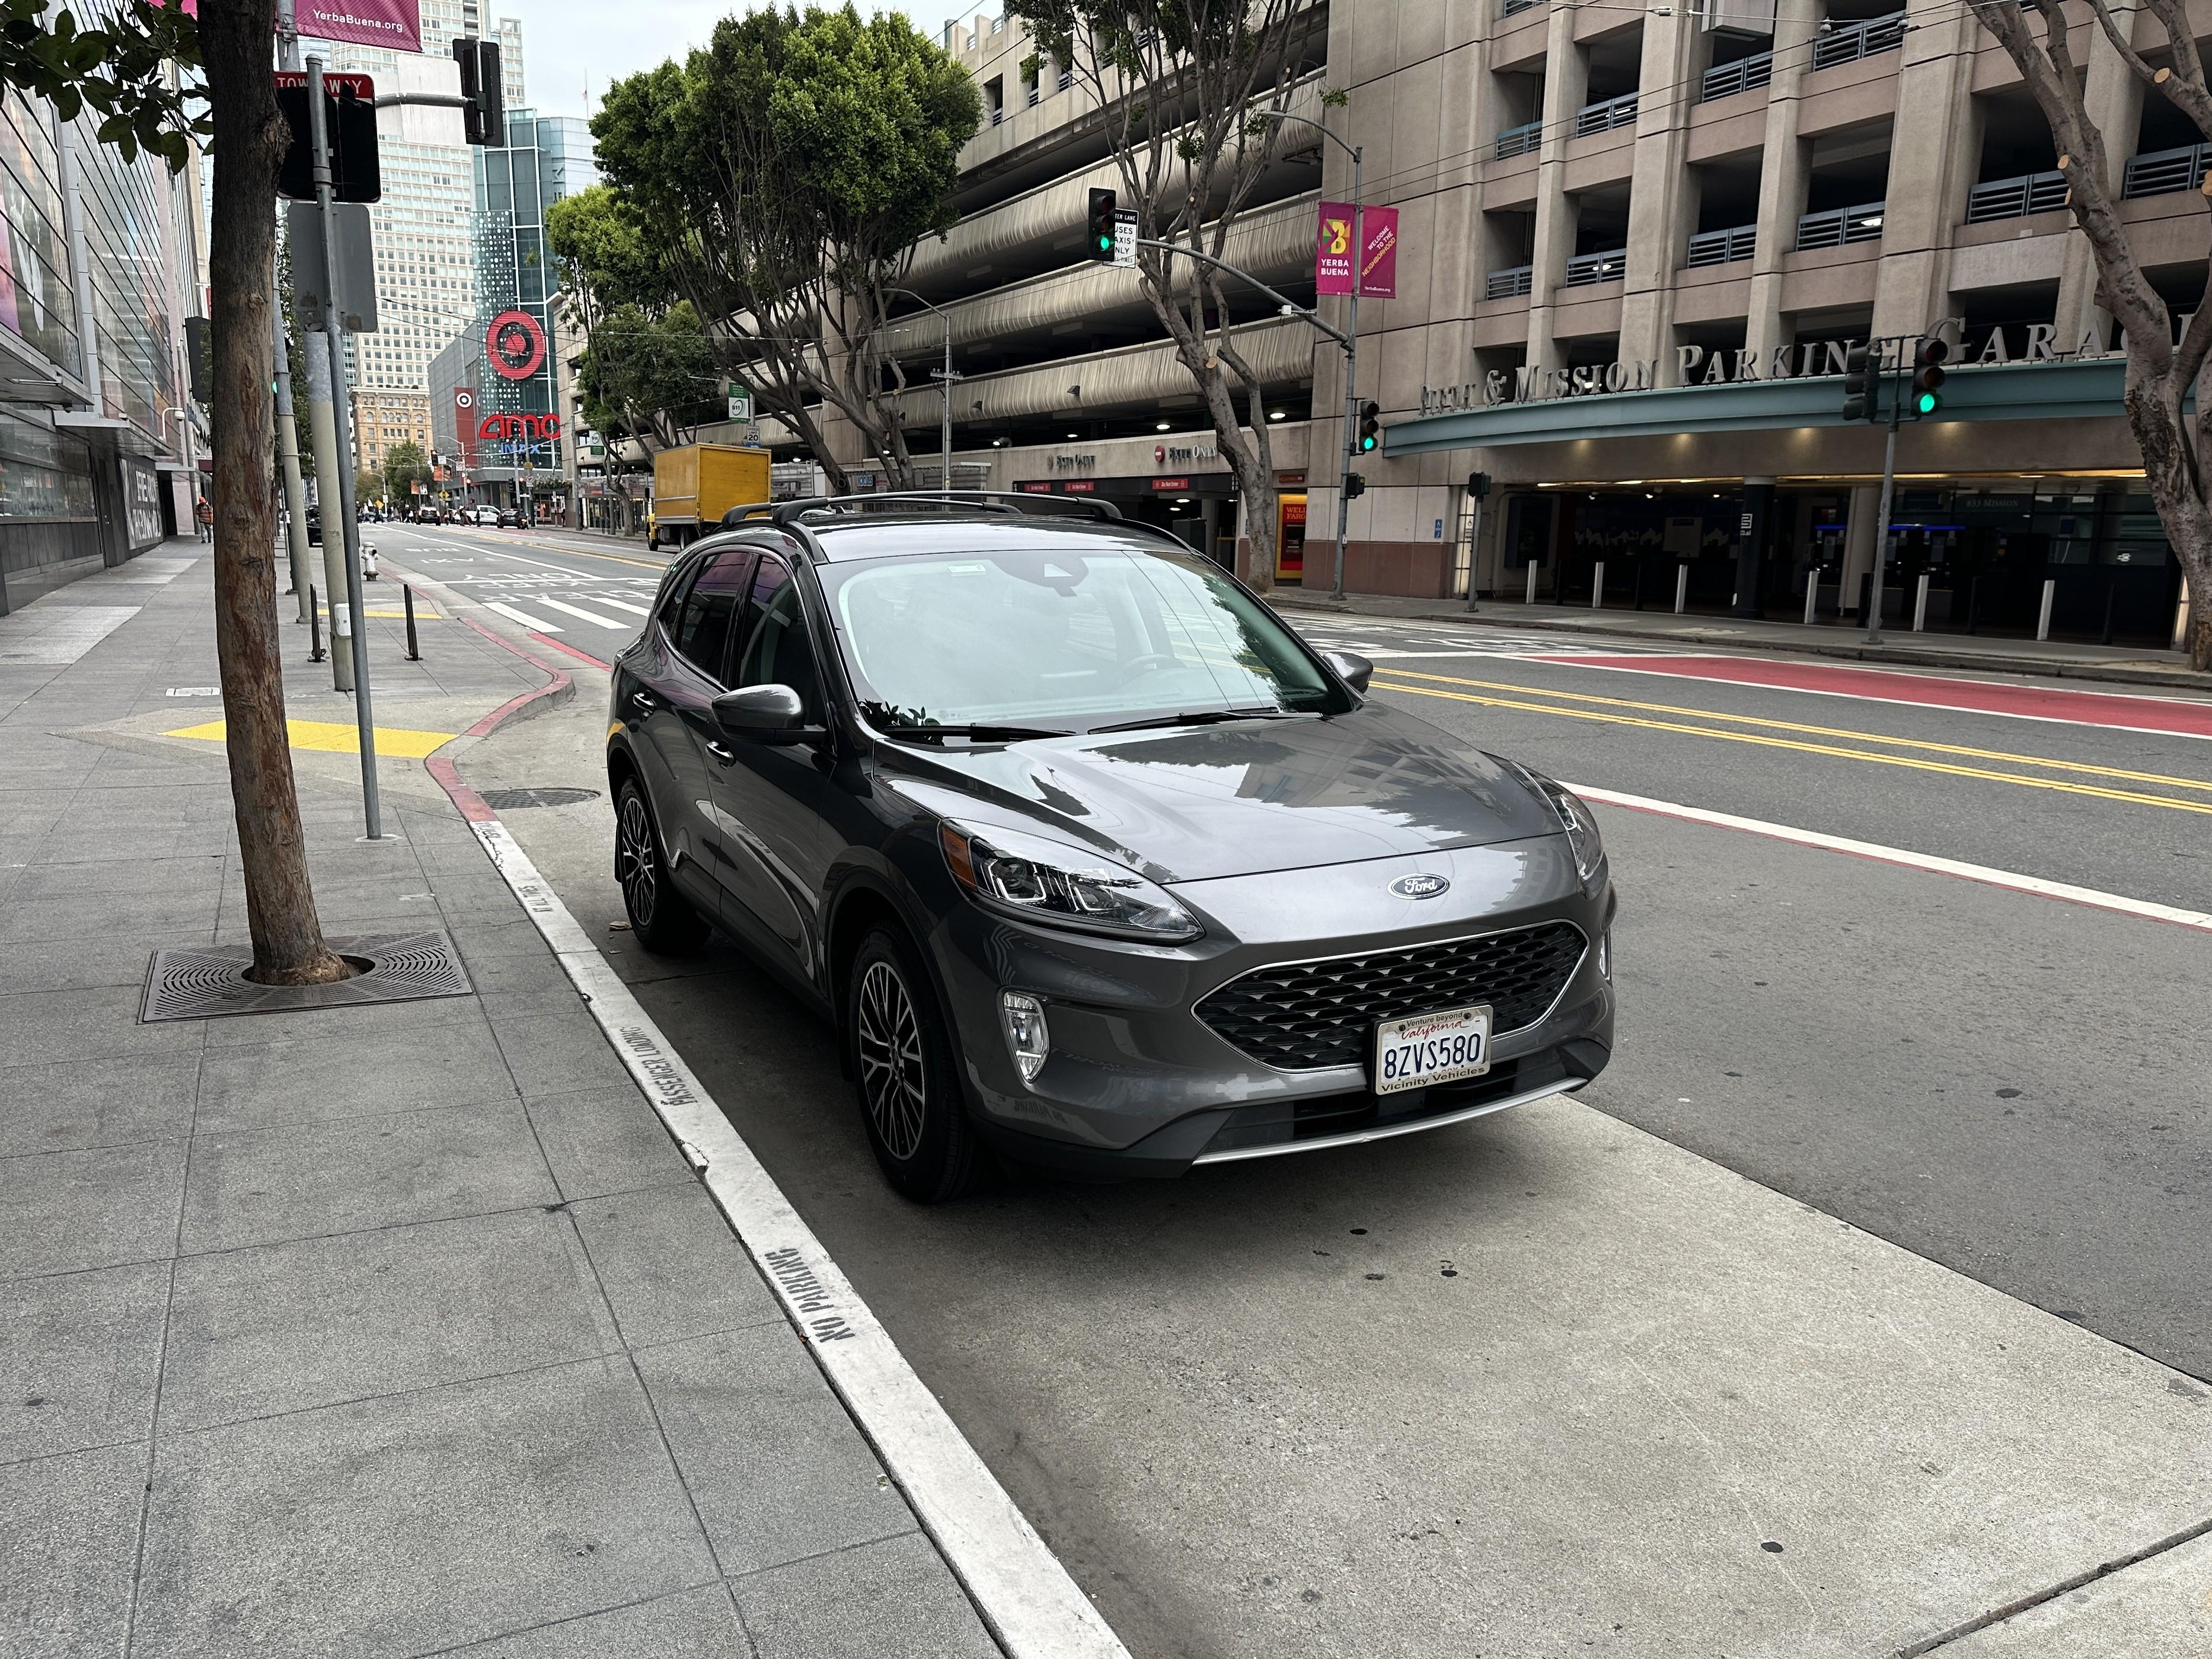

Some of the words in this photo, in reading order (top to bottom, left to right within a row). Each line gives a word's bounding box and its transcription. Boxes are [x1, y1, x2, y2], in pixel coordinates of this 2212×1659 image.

[312, 9, 403, 33] YerbaBuena.org
[1115, 225, 1133, 235] USES
[1115, 236, 1131, 244] AXIS
[1367, 225, 1390, 251] WELCOME
[1375, 241, 1384, 250] TO
[1383, 230, 1394, 244] THE
[1115, 246, 1130, 254] NLY
[1361, 237, 1396, 277] NEIGHBORHOOD
[1321, 258, 1349, 267] YERBA
[1321, 267, 1349, 276] BUENA
[1483, 369, 1507, 406] &
[1512, 358, 1659, 404] MISSION
[1925, 313, 2196, 365] GARA
[1192, 445, 1217, 458] ONLY
[1967, 499, 1982, 508] 833
[1983, 499, 2019, 508] MISSION
[462, 572, 572, 581] ONLY
[475, 580, 595, 589] KEEP
[1404, 877, 1438, 894] Ford
[1401, 1019, 1470, 1041] California
[1406, 1016, 1435, 1028] Venture
[619, 1026, 661, 1057] LOADING
[1384, 1032, 1482, 1080] 8ZVS580
[641, 1057, 698, 1106] PASSENGER
[1381, 1077, 1429, 1092] Vicinity
[1432, 1066, 1486, 1081] Vehicles
[764, 1248, 835, 1314] PARKING
[810, 1316, 856, 1343] NO
